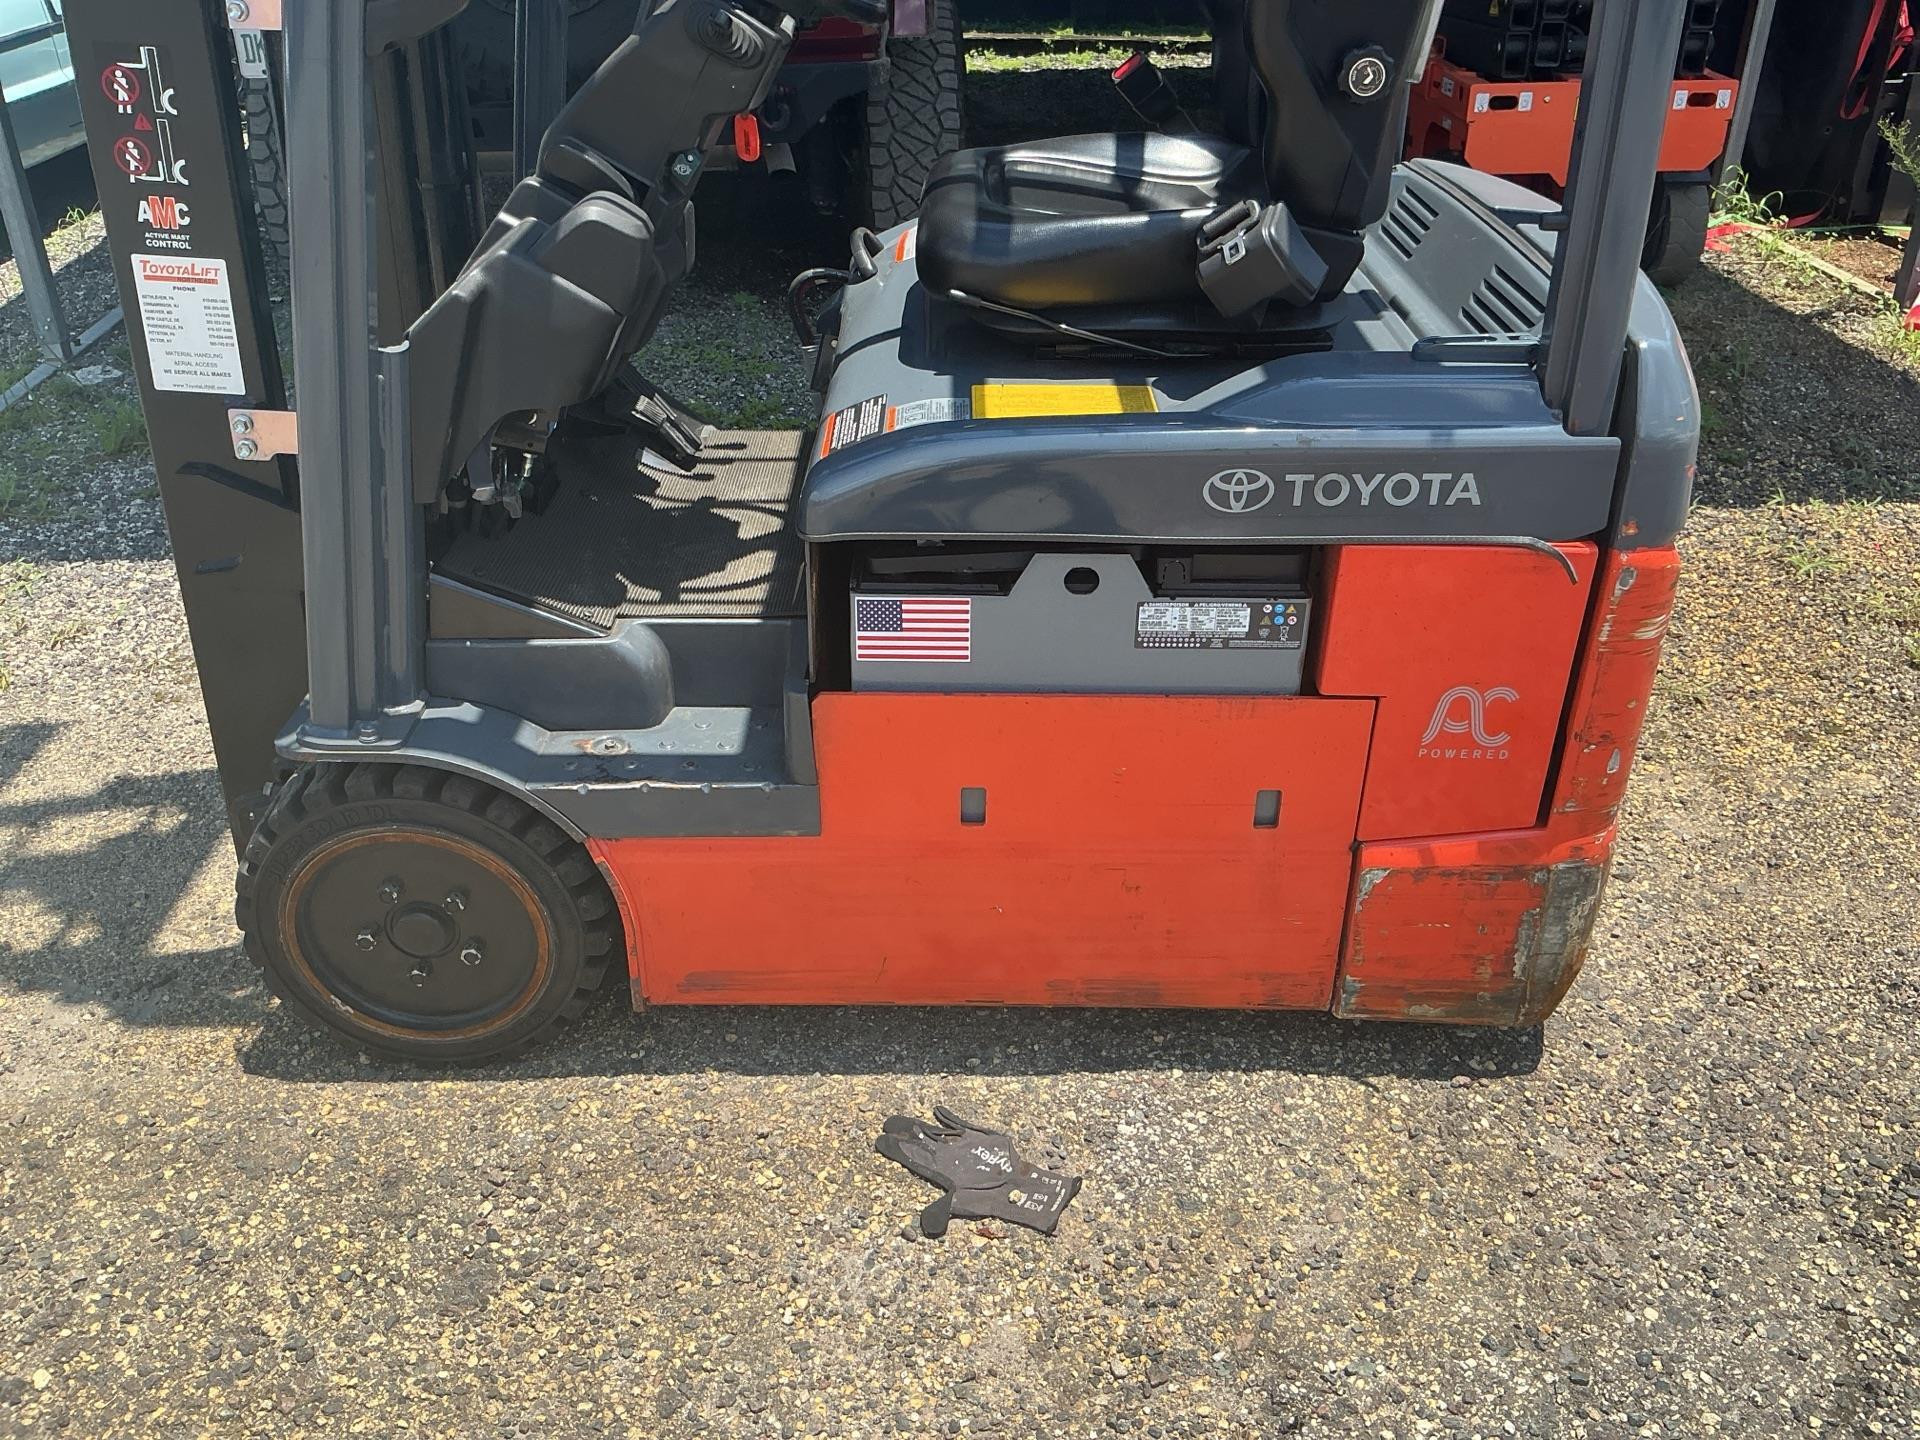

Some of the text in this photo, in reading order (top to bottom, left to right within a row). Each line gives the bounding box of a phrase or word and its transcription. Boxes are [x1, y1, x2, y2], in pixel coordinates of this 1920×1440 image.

[138, 195, 191, 230] AMC
[145, 239, 192, 250] CONTROL
[139, 260, 220, 277] TOYOTALIFT
[165, 350, 223, 360] MATERIAL HANDLING
[174, 360, 218, 369] AERIAL ACCESS
[174, 369, 198, 377] SERVICE
[1285, 472, 1481, 507] TOYOTA
[1420, 686, 1520, 747] AC
[1418, 748, 1509, 760] POWERED
